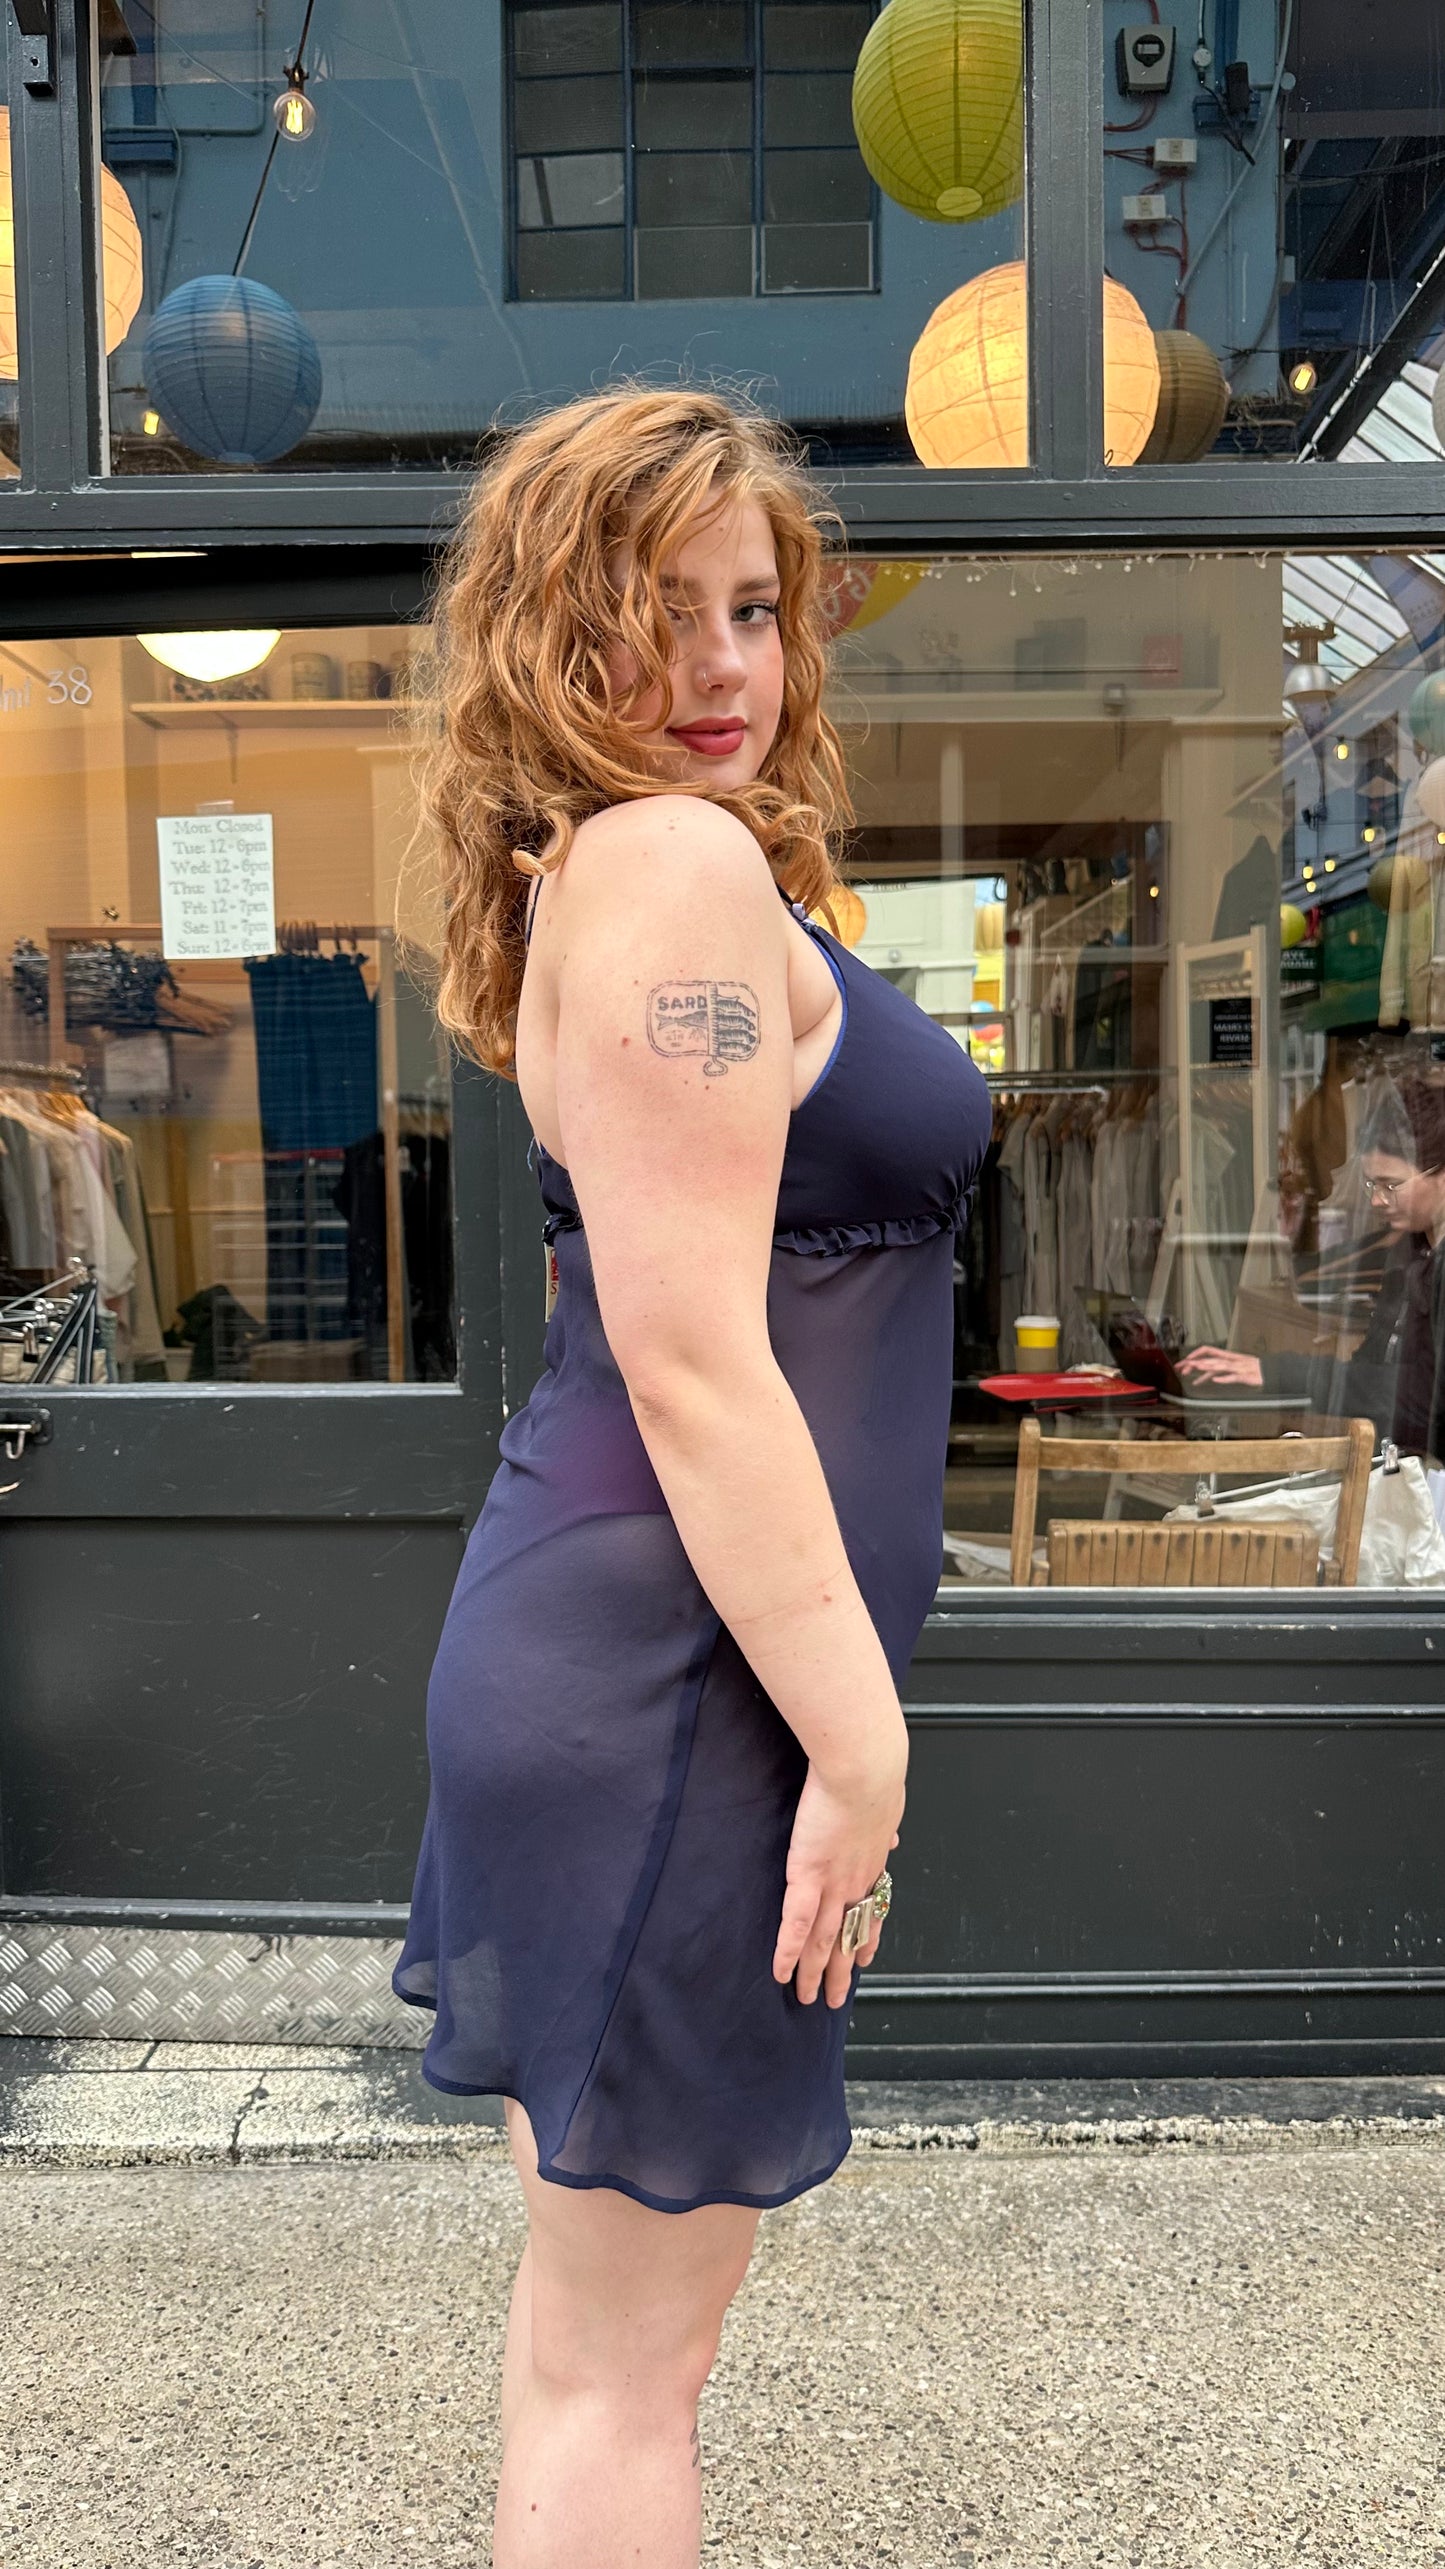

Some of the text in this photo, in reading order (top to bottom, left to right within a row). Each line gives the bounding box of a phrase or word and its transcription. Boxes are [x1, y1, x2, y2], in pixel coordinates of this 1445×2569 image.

[0, 665, 92, 712] nit 38
[174, 819, 263, 835] Mon: Closed
[172, 841, 205, 855] Tue:
[210, 839, 227, 853] 12
[236, 839, 267, 855] 6pm
[170, 860, 211, 874] Wed:
[215, 859, 231, 873] 12
[241, 859, 270, 876] 6pm
[168, 880, 205, 895] Thu:
[214, 878, 231, 893] 12
[242, 878, 269, 896] 7pm
[181, 901, 208, 914] Fri:
[211, 898, 228, 913] 12
[239, 899, 268, 916] 7pm
[183, 920, 209, 934] Sat:
[214, 920, 227, 934] 11
[241, 918, 268, 936] 7pm
[177, 941, 210, 954] Sun:
[215, 939, 231, 953] 12
[241, 939, 270, 955] 6pm
